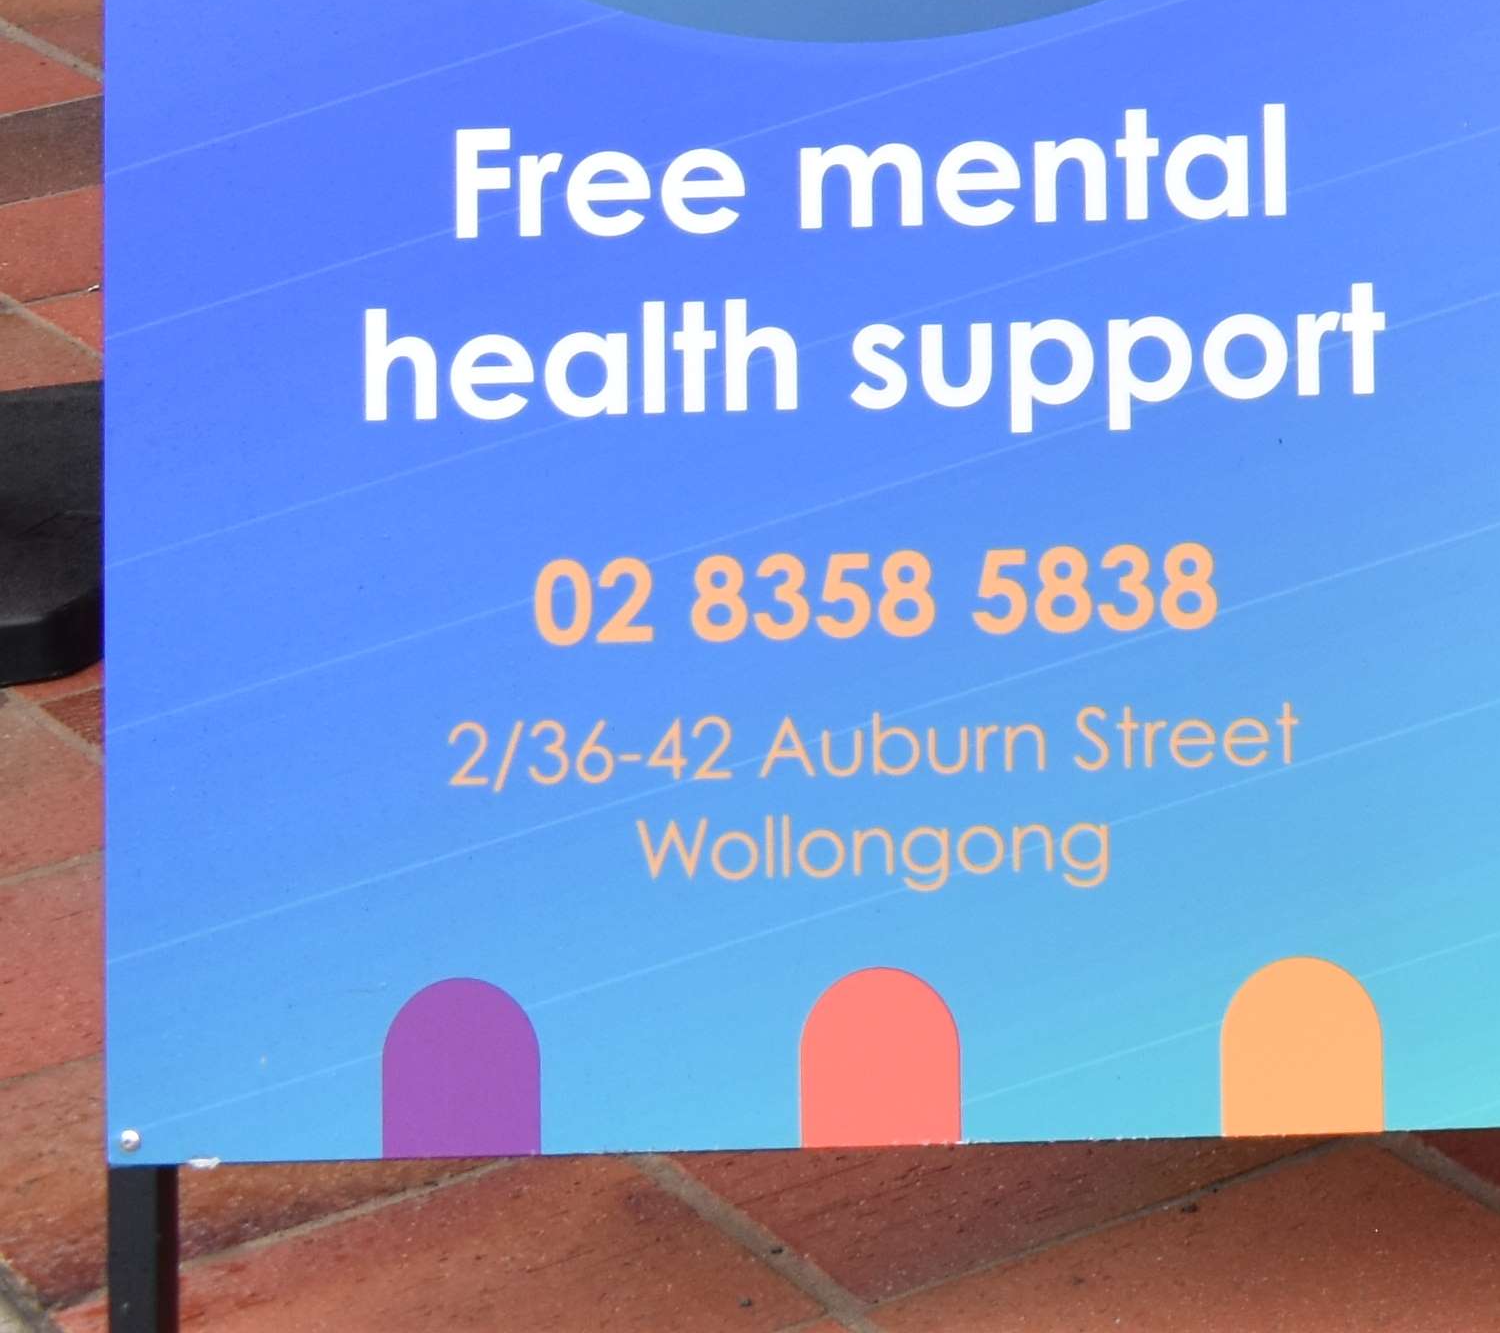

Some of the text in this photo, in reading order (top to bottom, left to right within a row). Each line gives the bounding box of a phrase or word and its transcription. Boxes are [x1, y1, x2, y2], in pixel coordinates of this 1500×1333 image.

[455, 103, 1288, 239] Free mental
[363, 282, 1386, 434] health support
[532, 542, 1219, 647] 02 8358 5838
[447, 701, 1299, 792] 2/36-42 Auburn Street
[636, 816, 1111, 892] Wollongong
